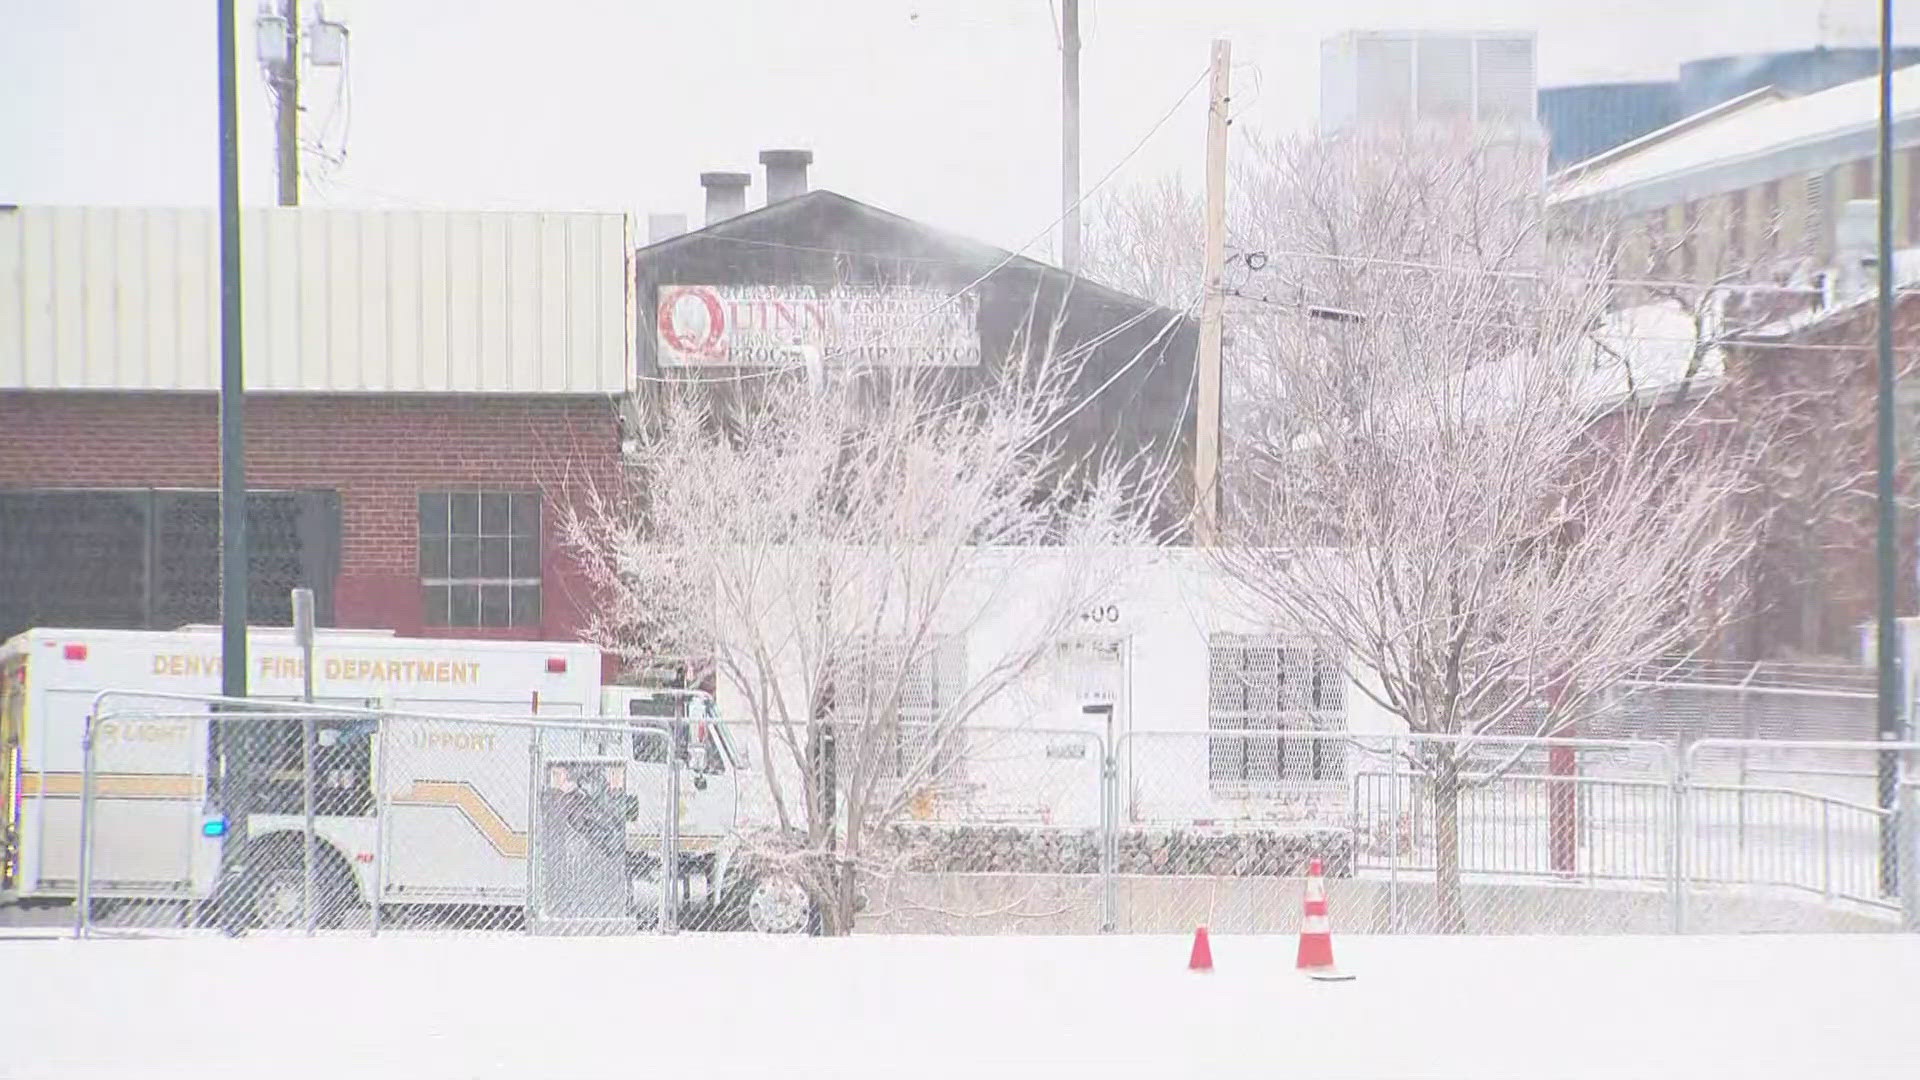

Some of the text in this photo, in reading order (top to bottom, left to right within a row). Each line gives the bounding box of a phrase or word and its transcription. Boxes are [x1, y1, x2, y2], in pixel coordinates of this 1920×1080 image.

[658, 287, 826, 356] QUINN
[153, 654, 223, 676] DENV
[325, 659, 480, 684] DEPARTMENT
[412, 731, 495, 751] UPPORT
